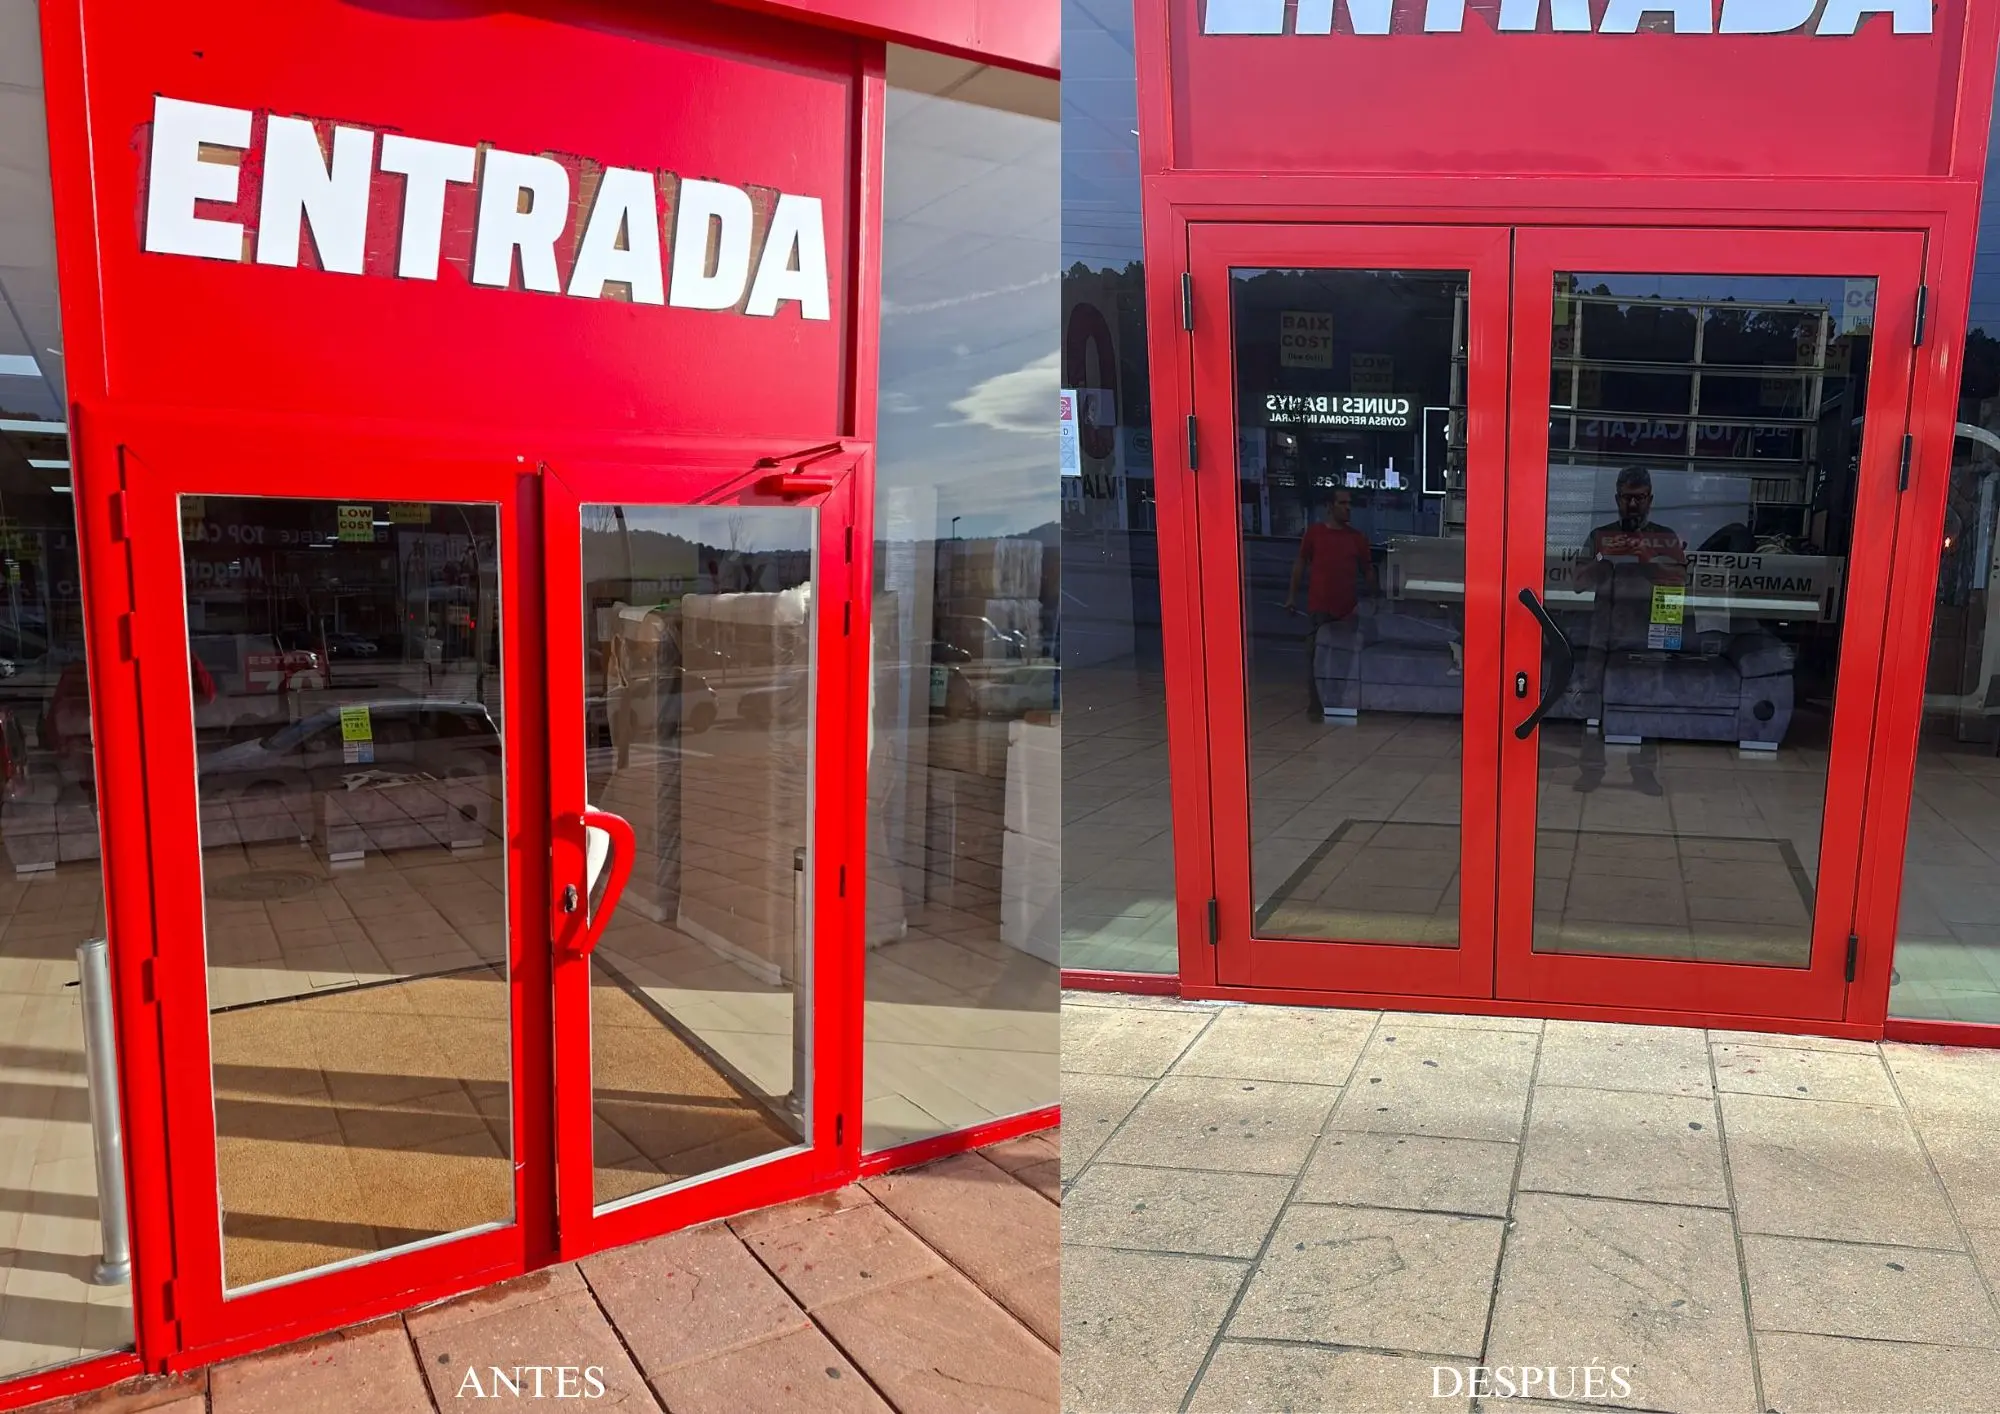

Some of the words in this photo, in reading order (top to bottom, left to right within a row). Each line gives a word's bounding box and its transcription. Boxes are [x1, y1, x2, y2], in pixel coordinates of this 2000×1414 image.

[144, 96, 830, 321] ENTRADA
[1283, 316, 1329, 331] BAIX
[1282, 335, 1330, 348] COST
[340, 508, 372, 518] LOW
[340, 521, 372, 530] COST
